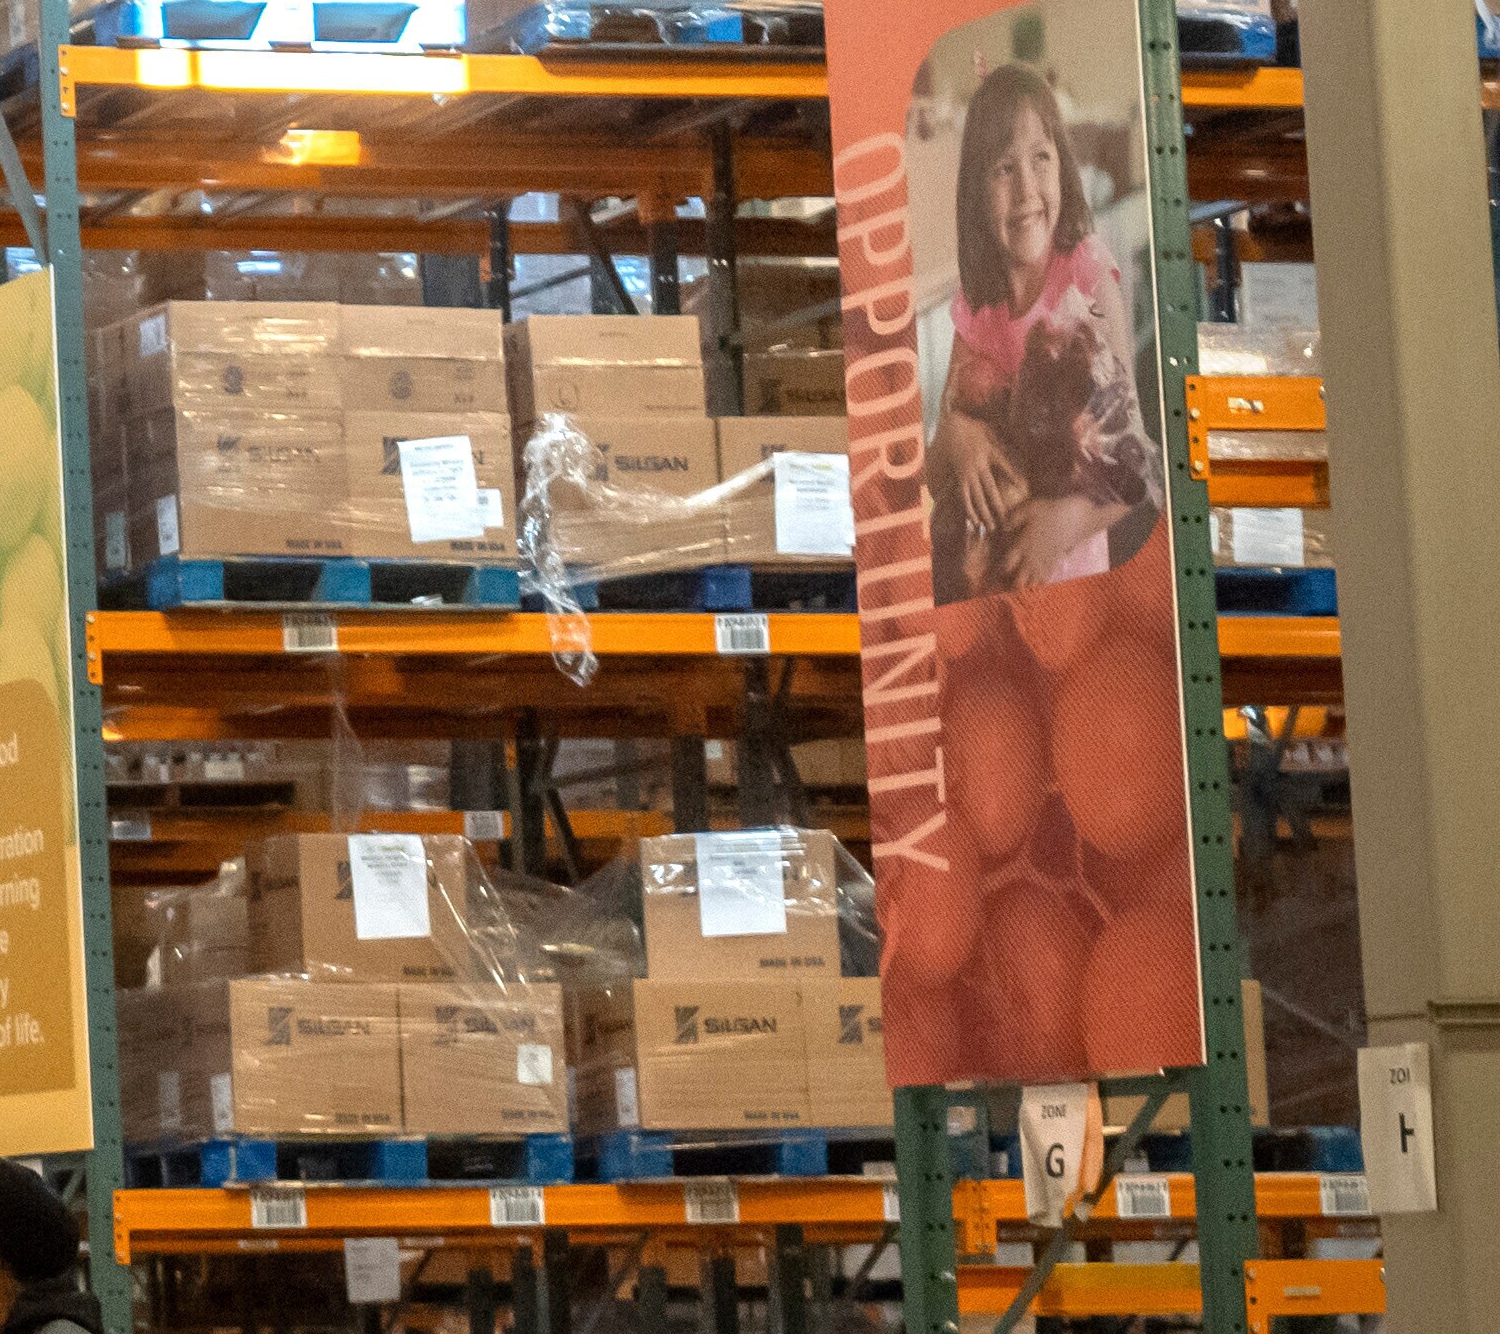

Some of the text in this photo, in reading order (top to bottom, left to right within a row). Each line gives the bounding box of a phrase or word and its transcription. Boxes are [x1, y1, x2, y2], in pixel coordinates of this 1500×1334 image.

[614, 455, 689, 472] SILGAN
[834, 130, 950, 874] OPPORTUNITY
[14, 1012, 45, 1046] life.
[703, 1017, 777, 1035] SILGAN
[1040, 1103, 1068, 1120] ZONE
[1045, 1142, 1065, 1179] G
